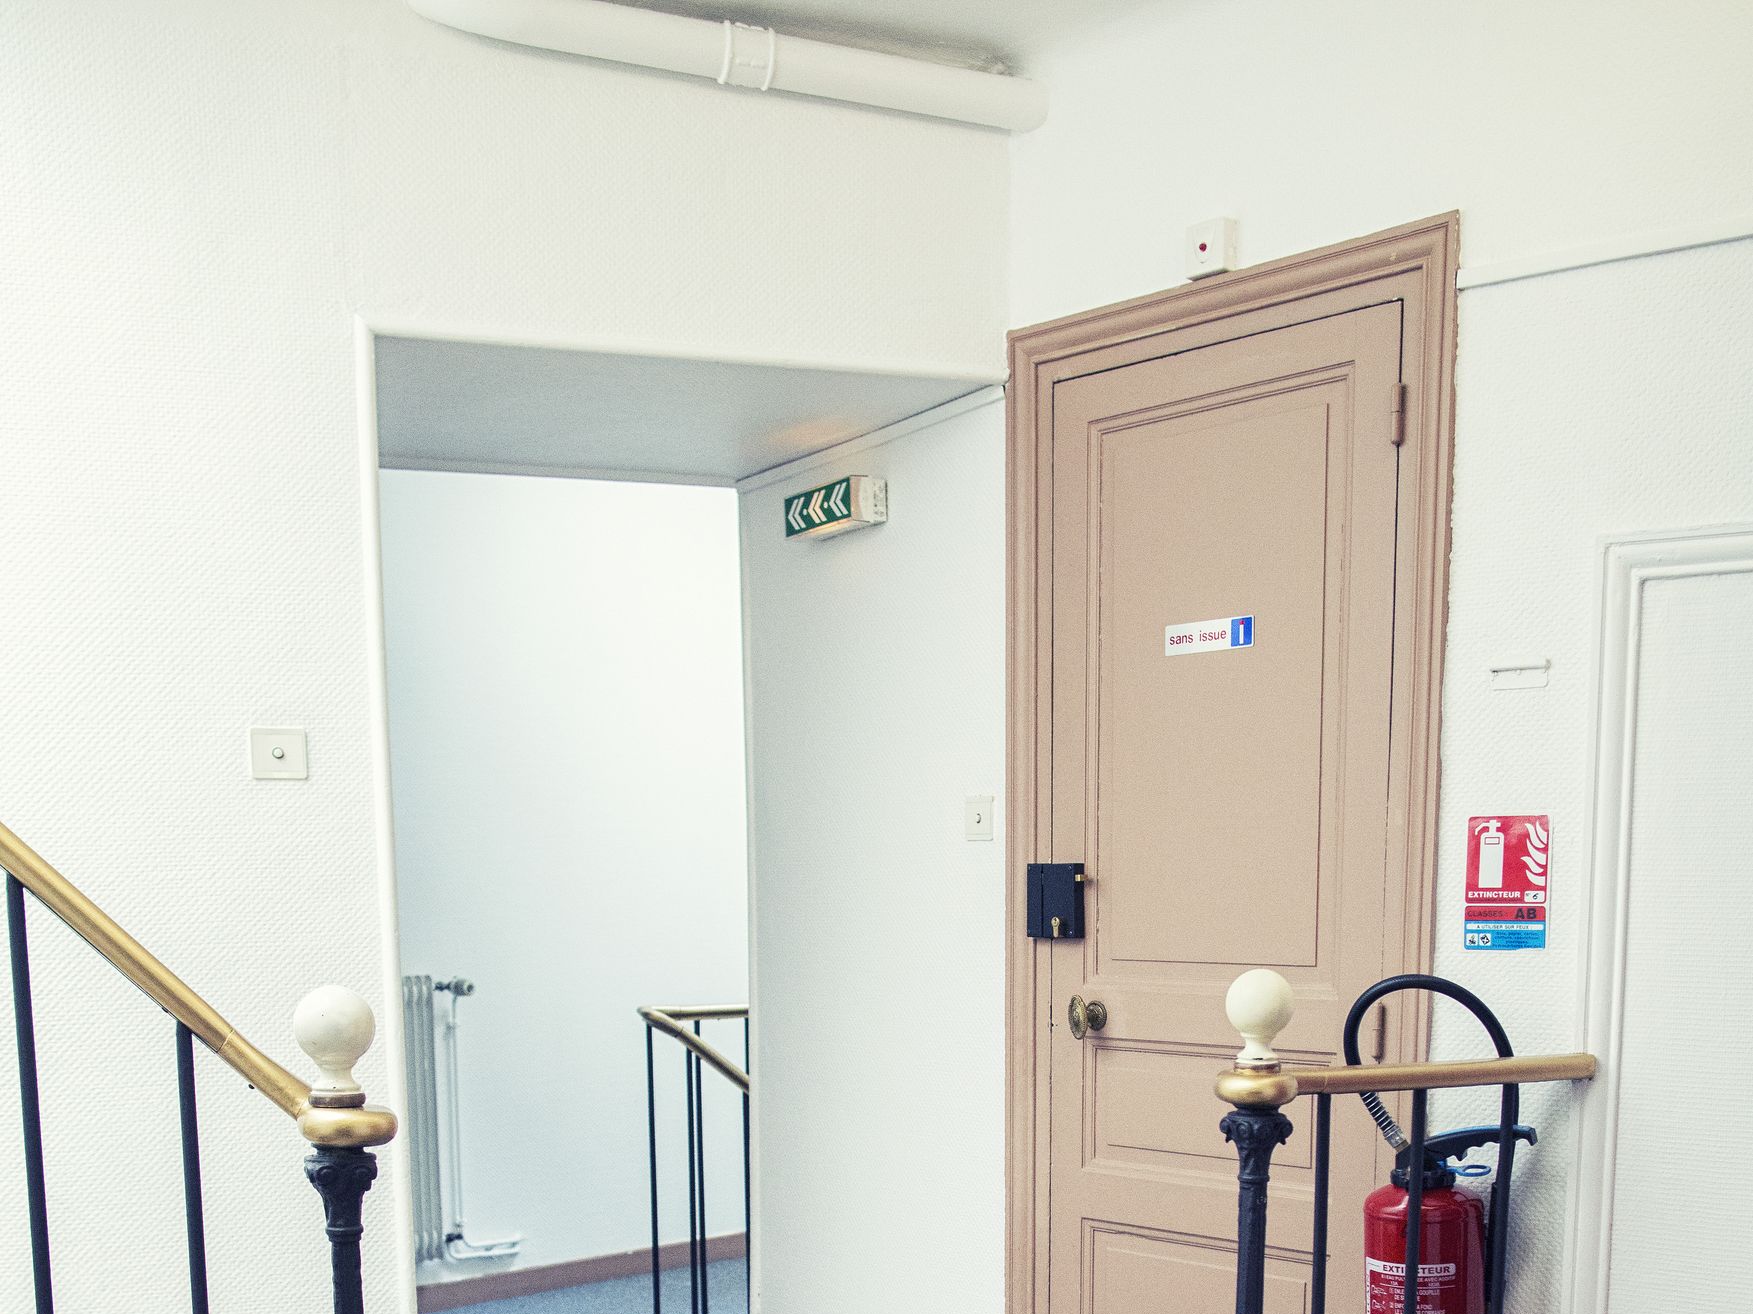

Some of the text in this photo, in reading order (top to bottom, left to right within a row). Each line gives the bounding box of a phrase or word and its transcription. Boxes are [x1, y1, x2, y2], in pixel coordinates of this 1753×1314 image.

[1169, 630, 1227, 645] sans issue
[1516, 908, 1536, 919] AB
[1383, 1264, 1450, 1274] EXTITEUR
